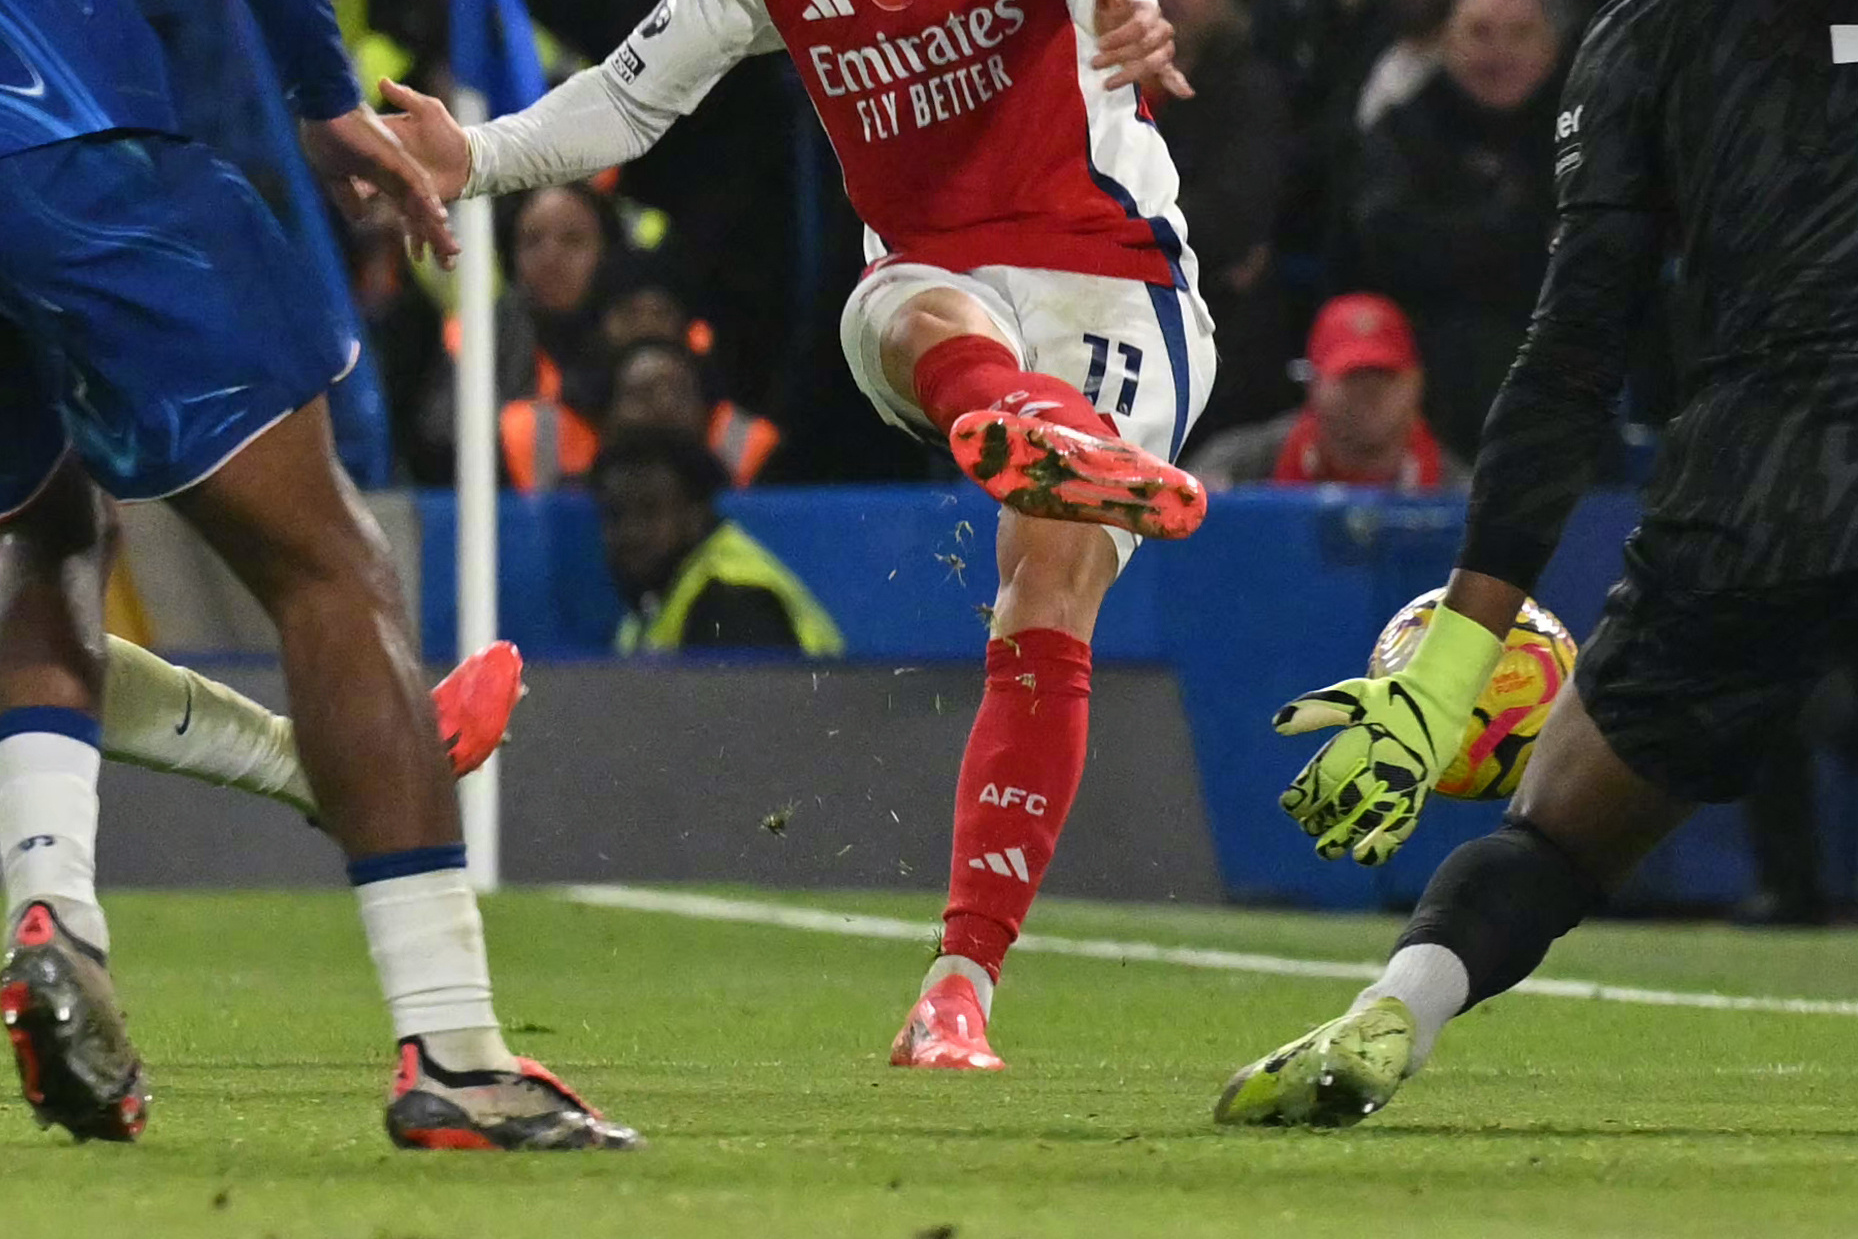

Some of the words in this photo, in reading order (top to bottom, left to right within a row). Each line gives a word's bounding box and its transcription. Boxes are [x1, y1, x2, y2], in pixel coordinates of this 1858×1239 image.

[855, 90, 900, 144] FLY
[908, 54, 1014, 129] BETTER
[1554, 103, 1584, 143] er
[1082, 332, 1144, 417] 11
[978, 781, 1048, 817] AFC
